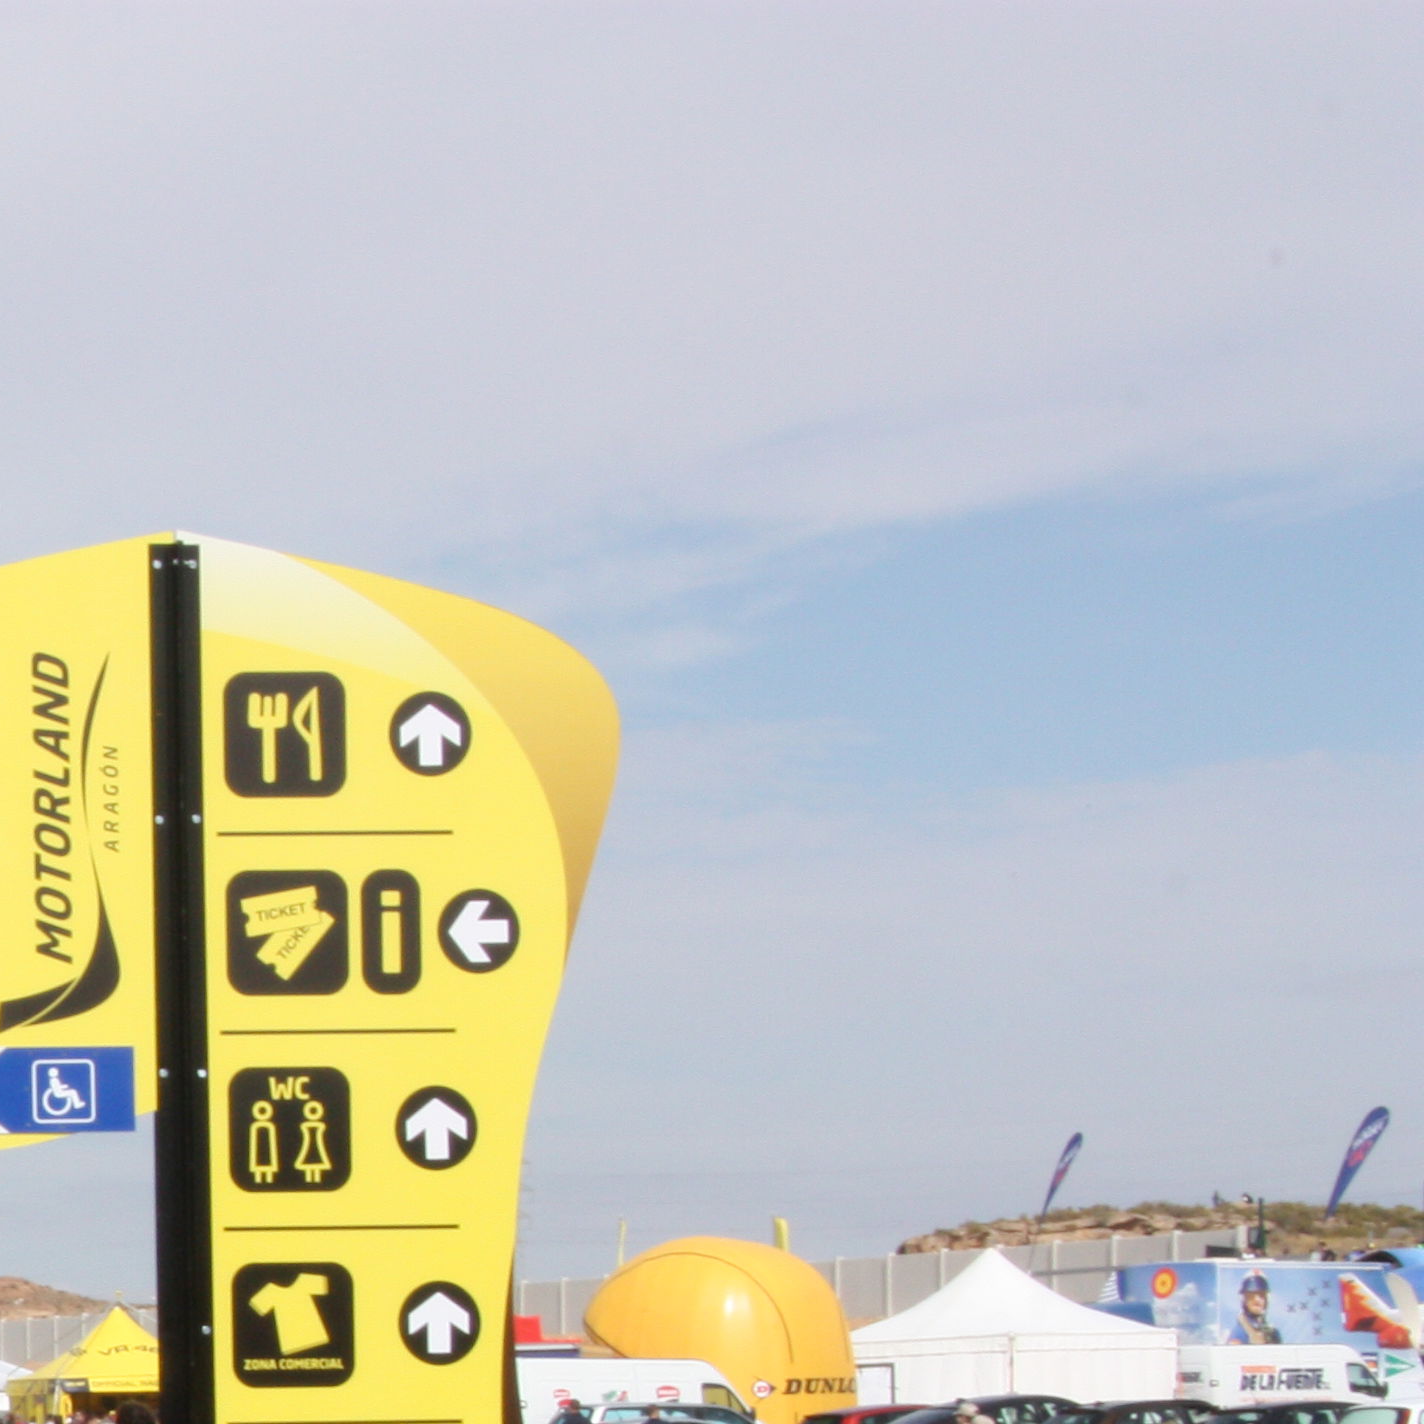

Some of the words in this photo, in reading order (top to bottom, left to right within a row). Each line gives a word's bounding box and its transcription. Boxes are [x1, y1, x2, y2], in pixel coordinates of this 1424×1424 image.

[32, 652, 73, 964] MOTORLAND
[100, 746, 120, 853] ARAGÓN
[256, 902, 305, 922] TICKET
[268, 1076, 310, 1100] WC
[243, 1358, 277, 1371] ZONA
[278, 1357, 344, 1370] COMERCIAL
